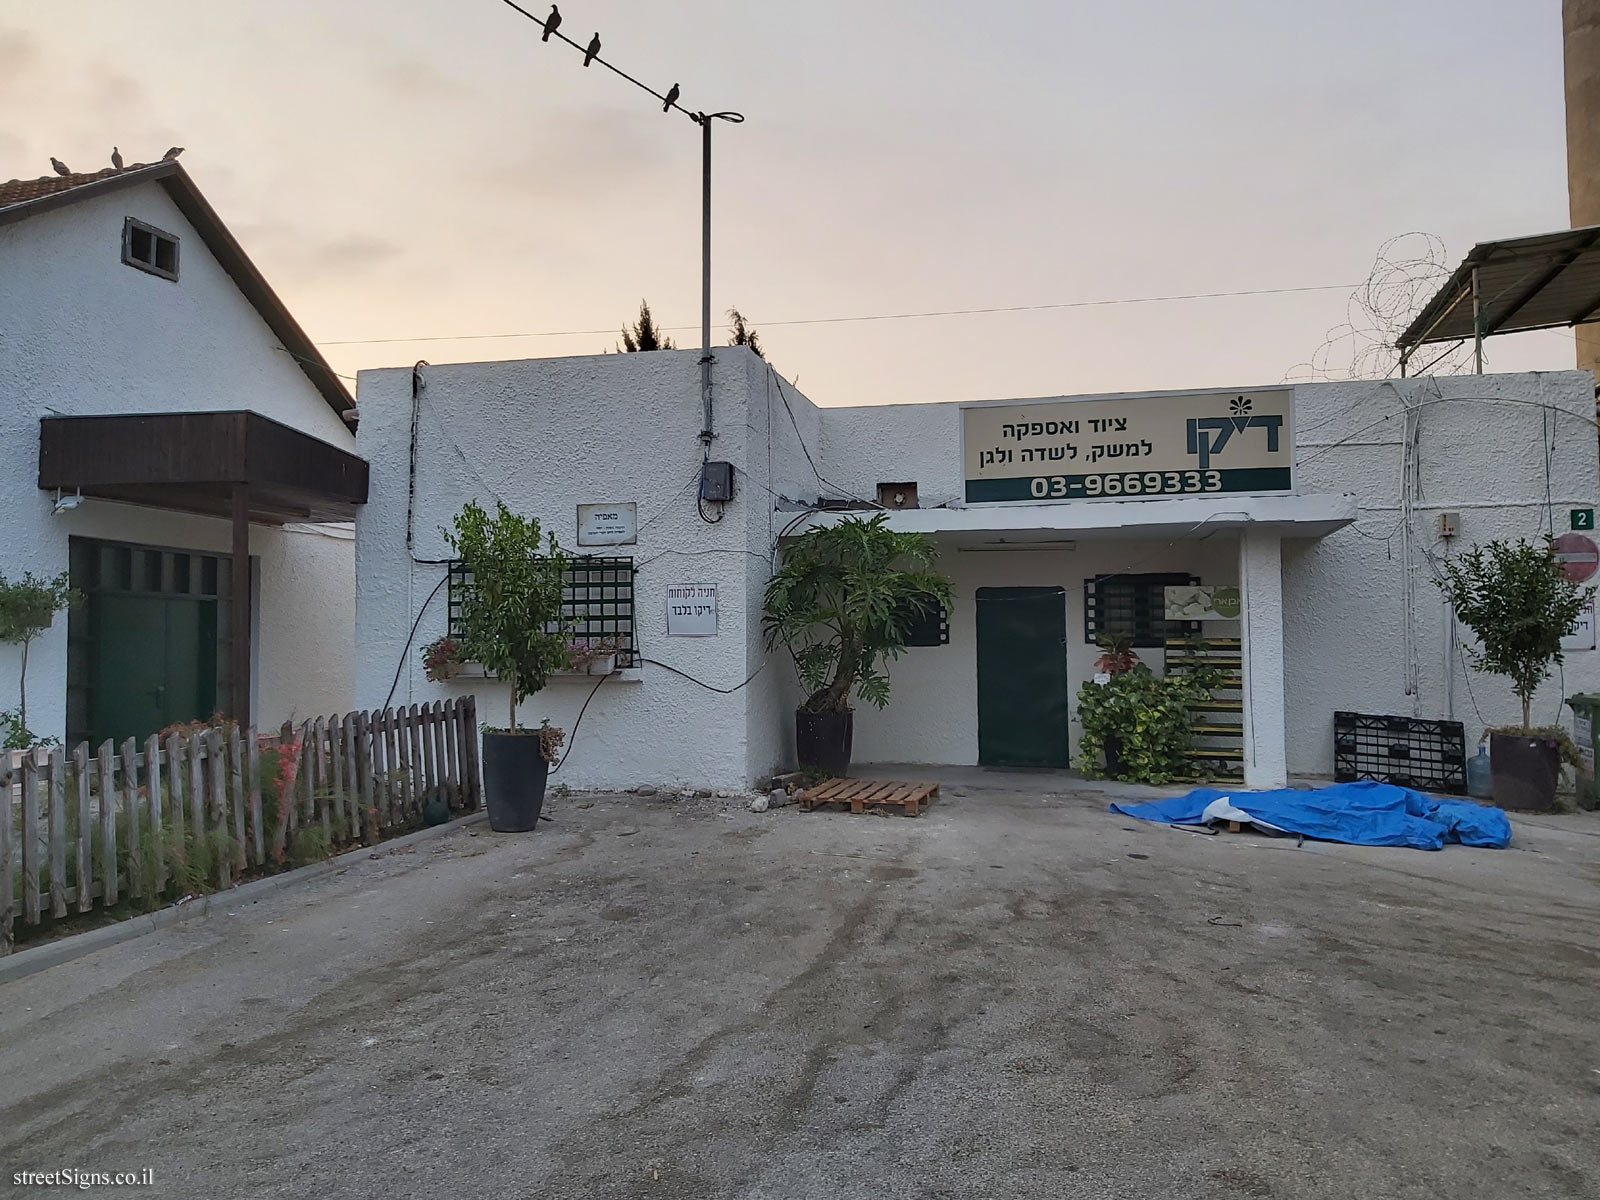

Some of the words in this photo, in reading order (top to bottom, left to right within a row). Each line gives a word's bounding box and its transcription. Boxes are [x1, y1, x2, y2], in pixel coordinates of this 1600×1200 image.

[1002, 421, 1079, 441] ואספקה
[1088, 417, 1128, 433] ציוד
[979, 447, 1013, 469] ולגן
[1021, 443, 1078, 461] לשדה
[1085, 439, 1153, 462] למשק,
[1030, 471, 1223, 498] 03-9669333
[594, 513, 618, 521] מאפיה
[1577, 512, 1587, 526] 2
[668, 587, 696, 600] לקוחות
[697, 588, 715, 598] חניה
[671, 604, 693, 616] בלבד
[694, 605, 711, 617] דיקו
